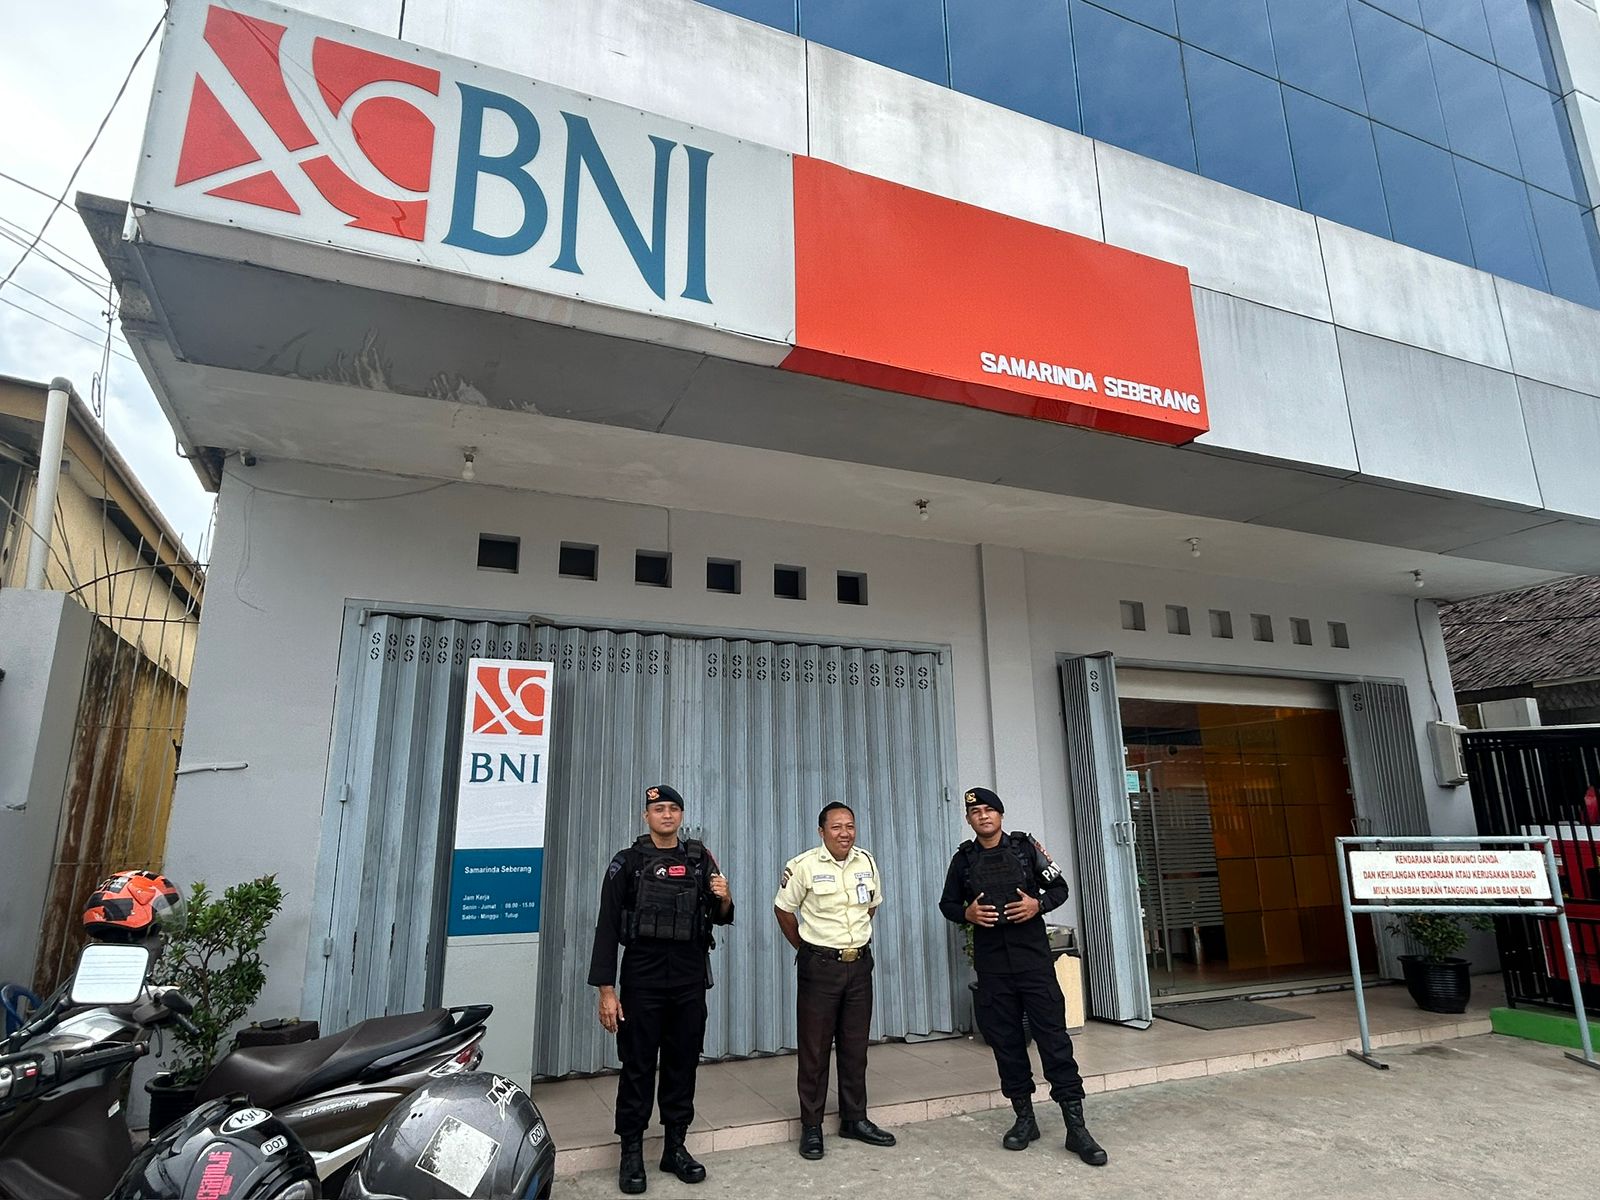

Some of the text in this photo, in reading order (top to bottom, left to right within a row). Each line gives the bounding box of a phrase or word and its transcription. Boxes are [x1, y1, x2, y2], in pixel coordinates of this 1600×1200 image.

[441, 81, 714, 304] BNI
[980, 351, 1201, 415] SAMARINDA SEBERANG
[469, 752, 541, 784] BNI
[1394, 855, 1499, 864] KENDARAAN AGAR DIKUNCI GANDA
[464, 865, 532, 874] Samarinda Seberang
[1363, 870, 1536, 879] DAN KEHILANGAN KENDARAAN ATAU KERUSAKAN BARANG
[1372, 886, 1532, 895] MILIK NASABAH BUKAN TANGGUNG JAWAB BANK BNI
[486, 1078, 517, 1105] INK
[264, 1137, 286, 1153] DOT
